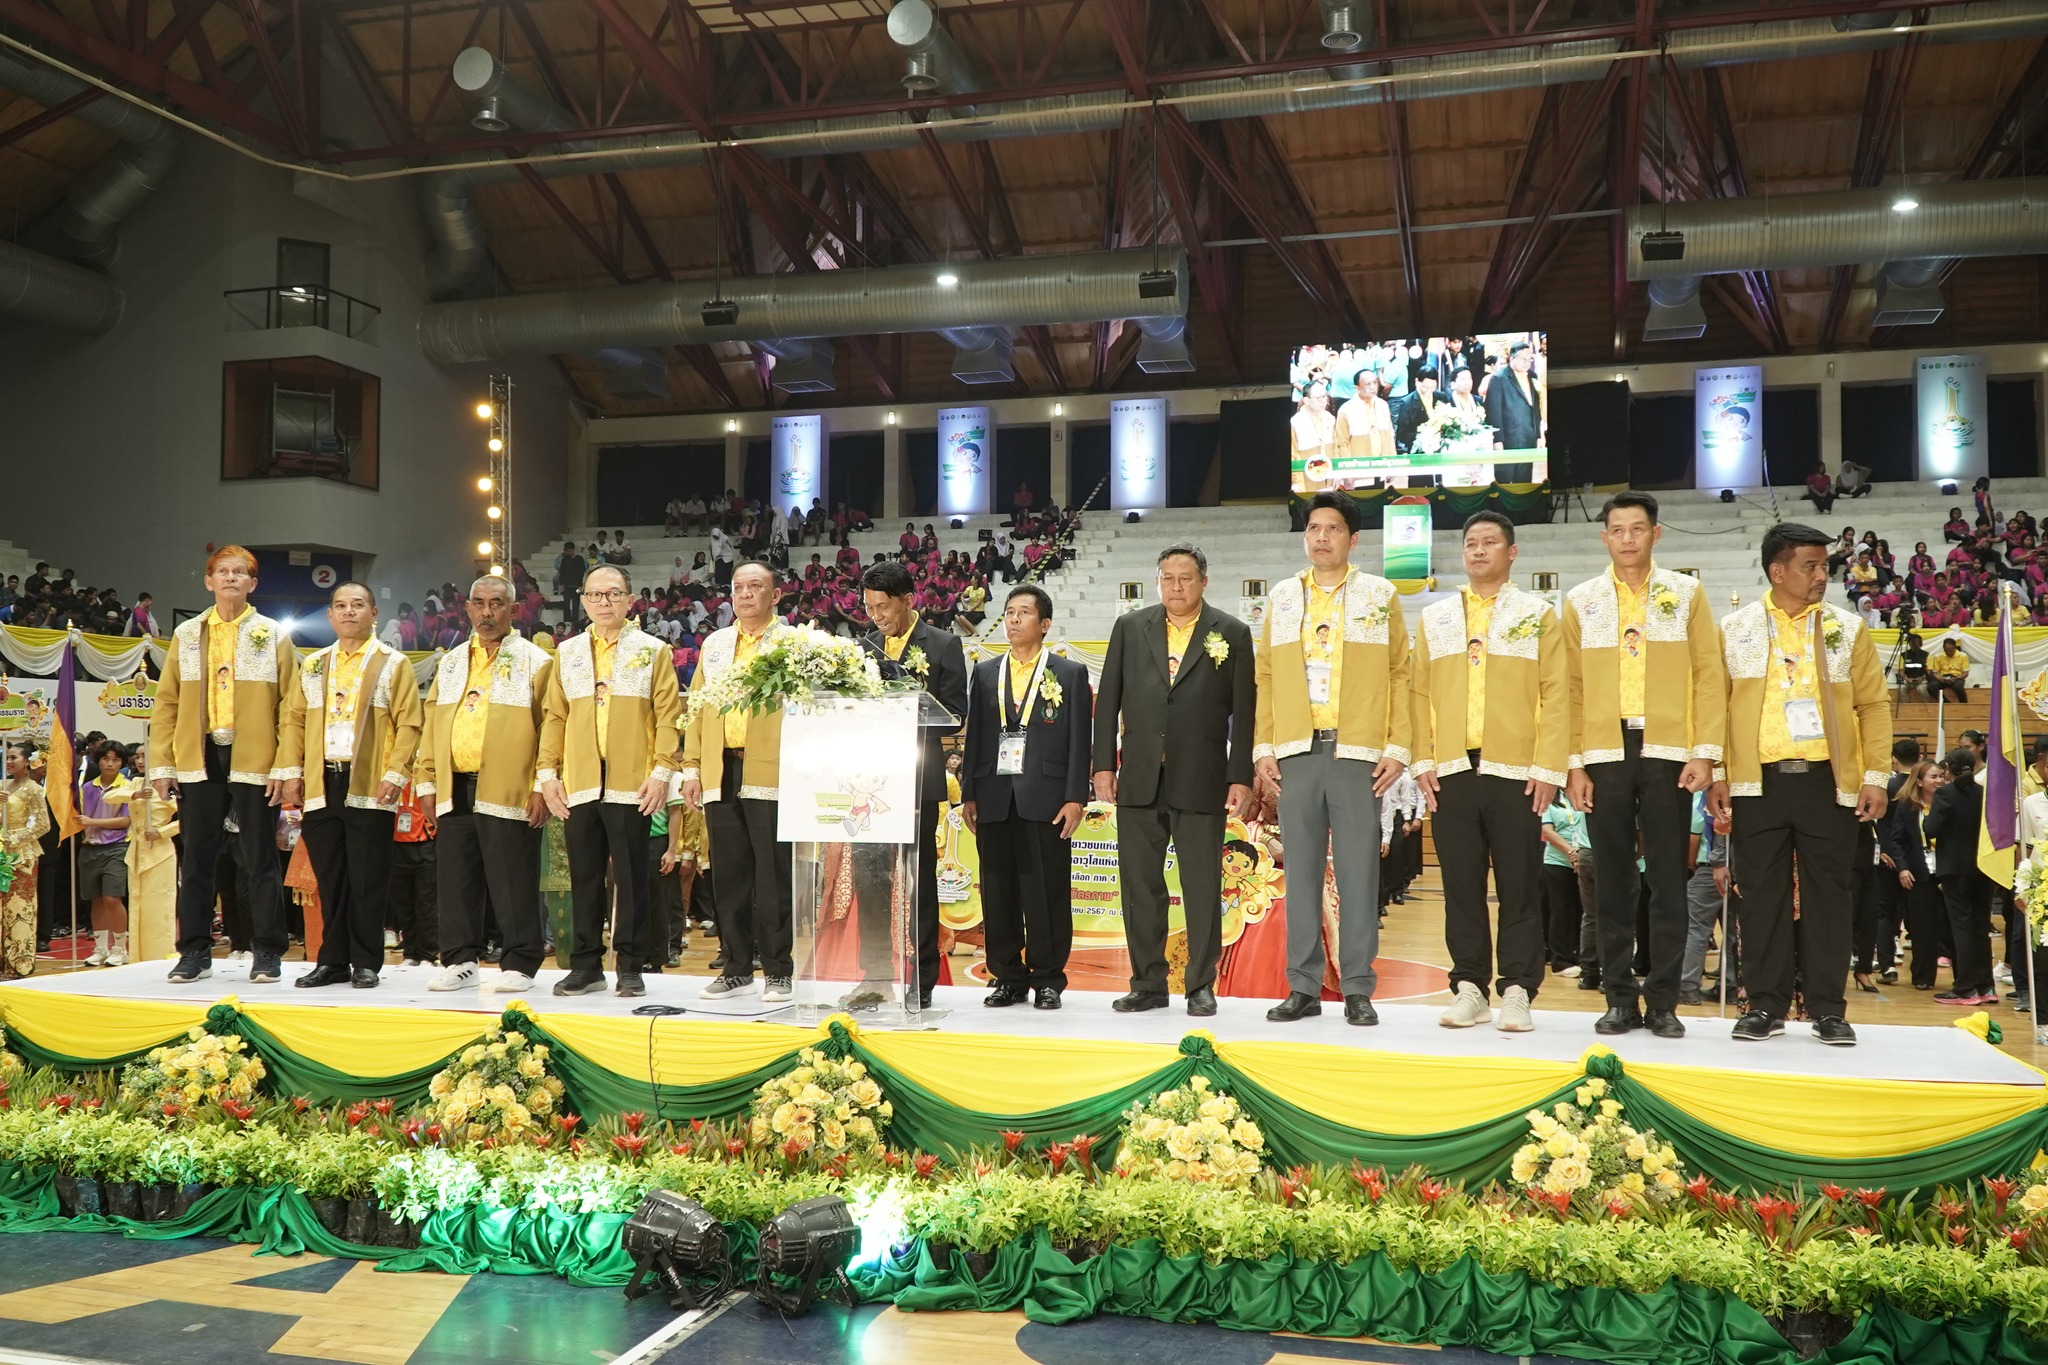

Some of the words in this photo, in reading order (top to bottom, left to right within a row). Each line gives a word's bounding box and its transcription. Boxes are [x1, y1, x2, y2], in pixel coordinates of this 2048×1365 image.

[318, 569, 330, 583] 2
[1070, 854, 1120, 868] อาวุโสแห่ง
[1086, 907, 1106, 915] 2567
